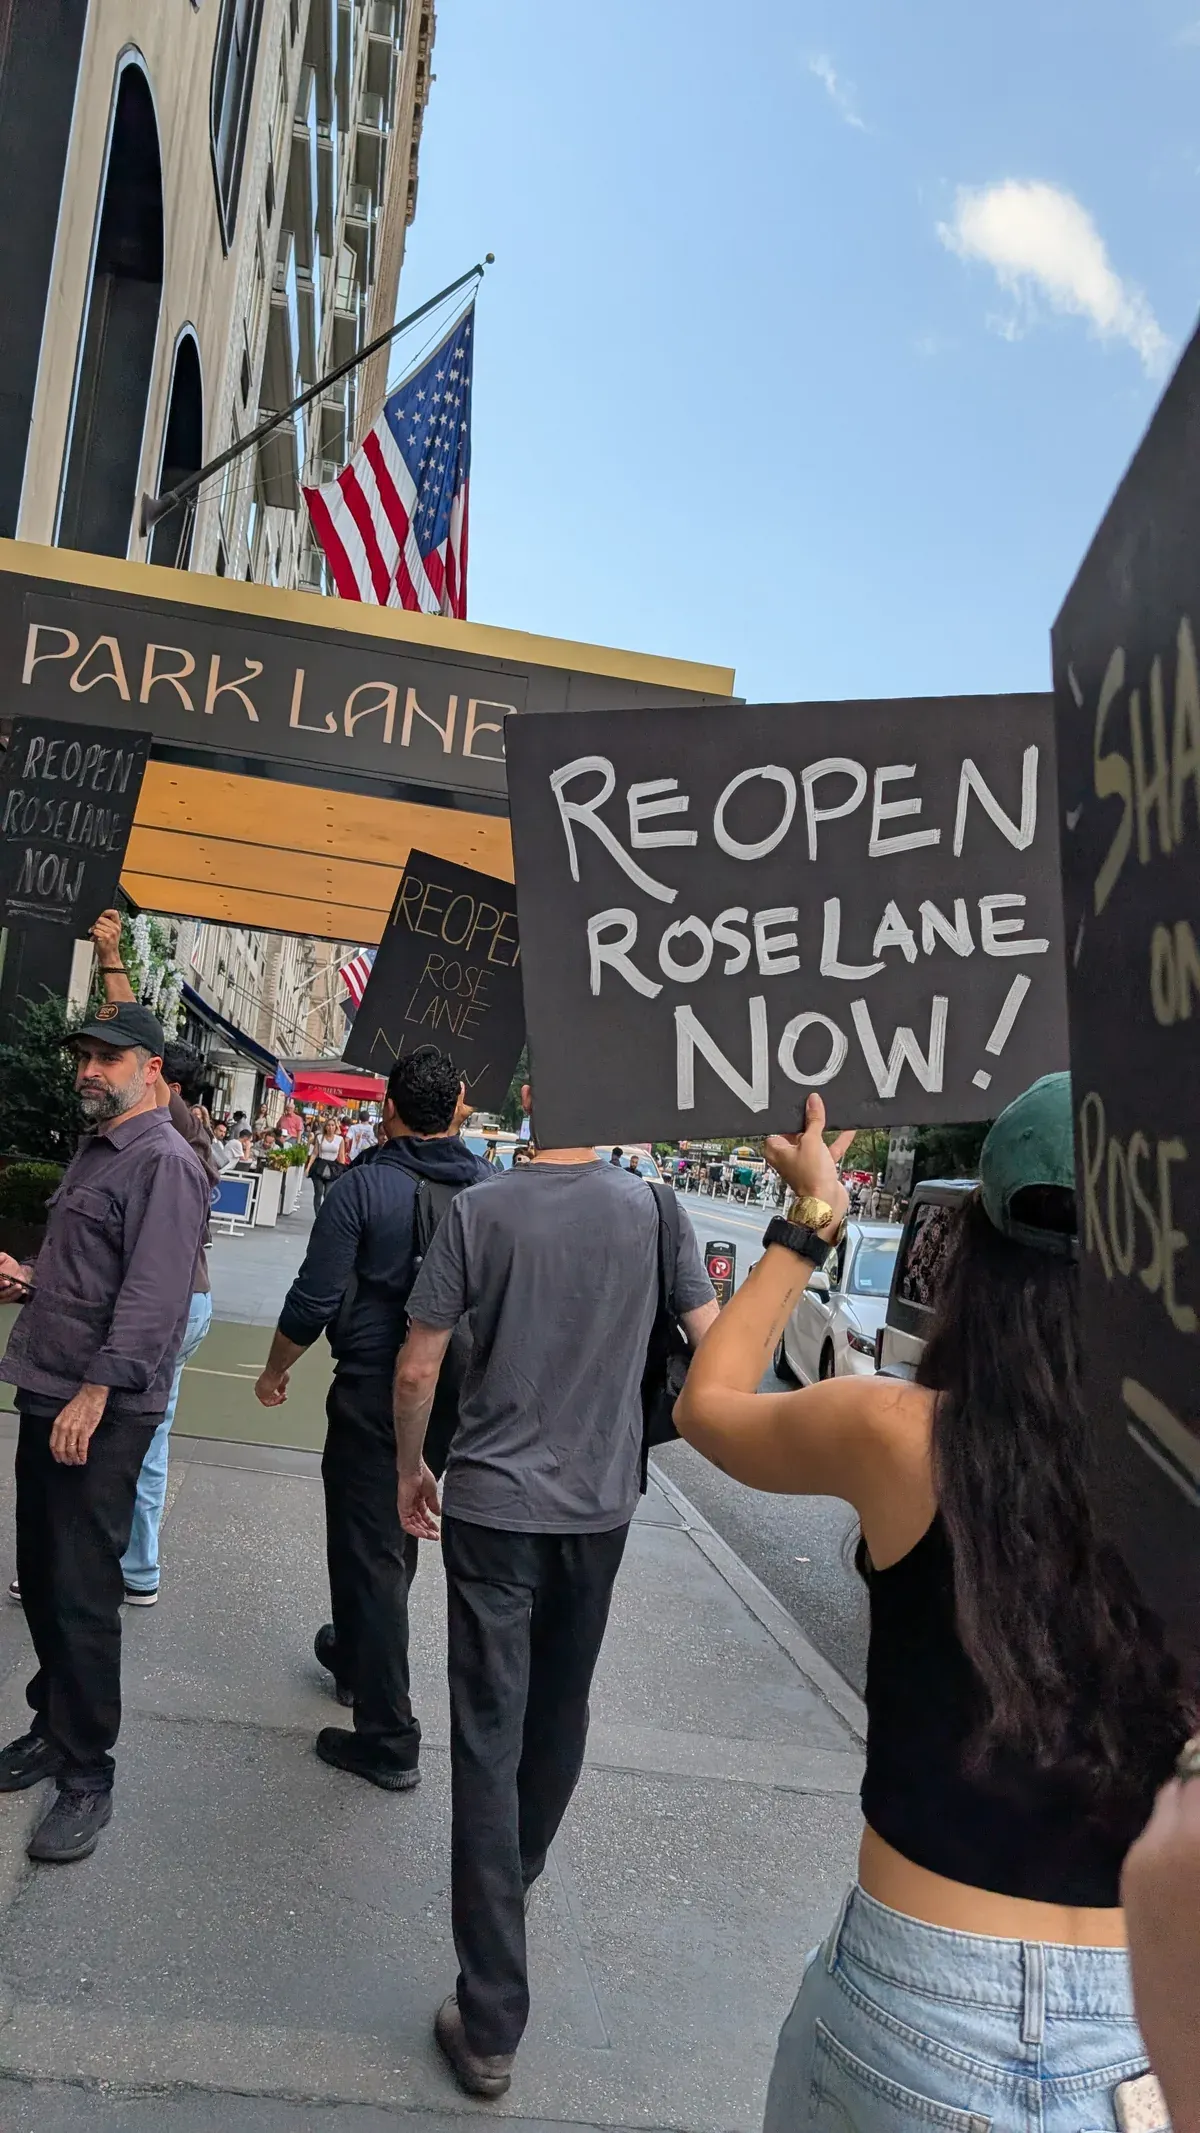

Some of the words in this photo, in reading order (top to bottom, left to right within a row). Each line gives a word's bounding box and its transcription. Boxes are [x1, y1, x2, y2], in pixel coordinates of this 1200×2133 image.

[22, 624, 263, 722] PARK
[289, 669, 517, 763] LANE
[22, 736, 134, 793] REOPEN
[550, 745, 1039, 903] REOPEN
[16, 848, 86, 902] NOW
[393, 876, 521, 967] REOPE
[404, 987, 487, 1041] LANE
[419, 953, 496, 1008] ROSE
[1079, 1090, 1198, 1334] ROSE
